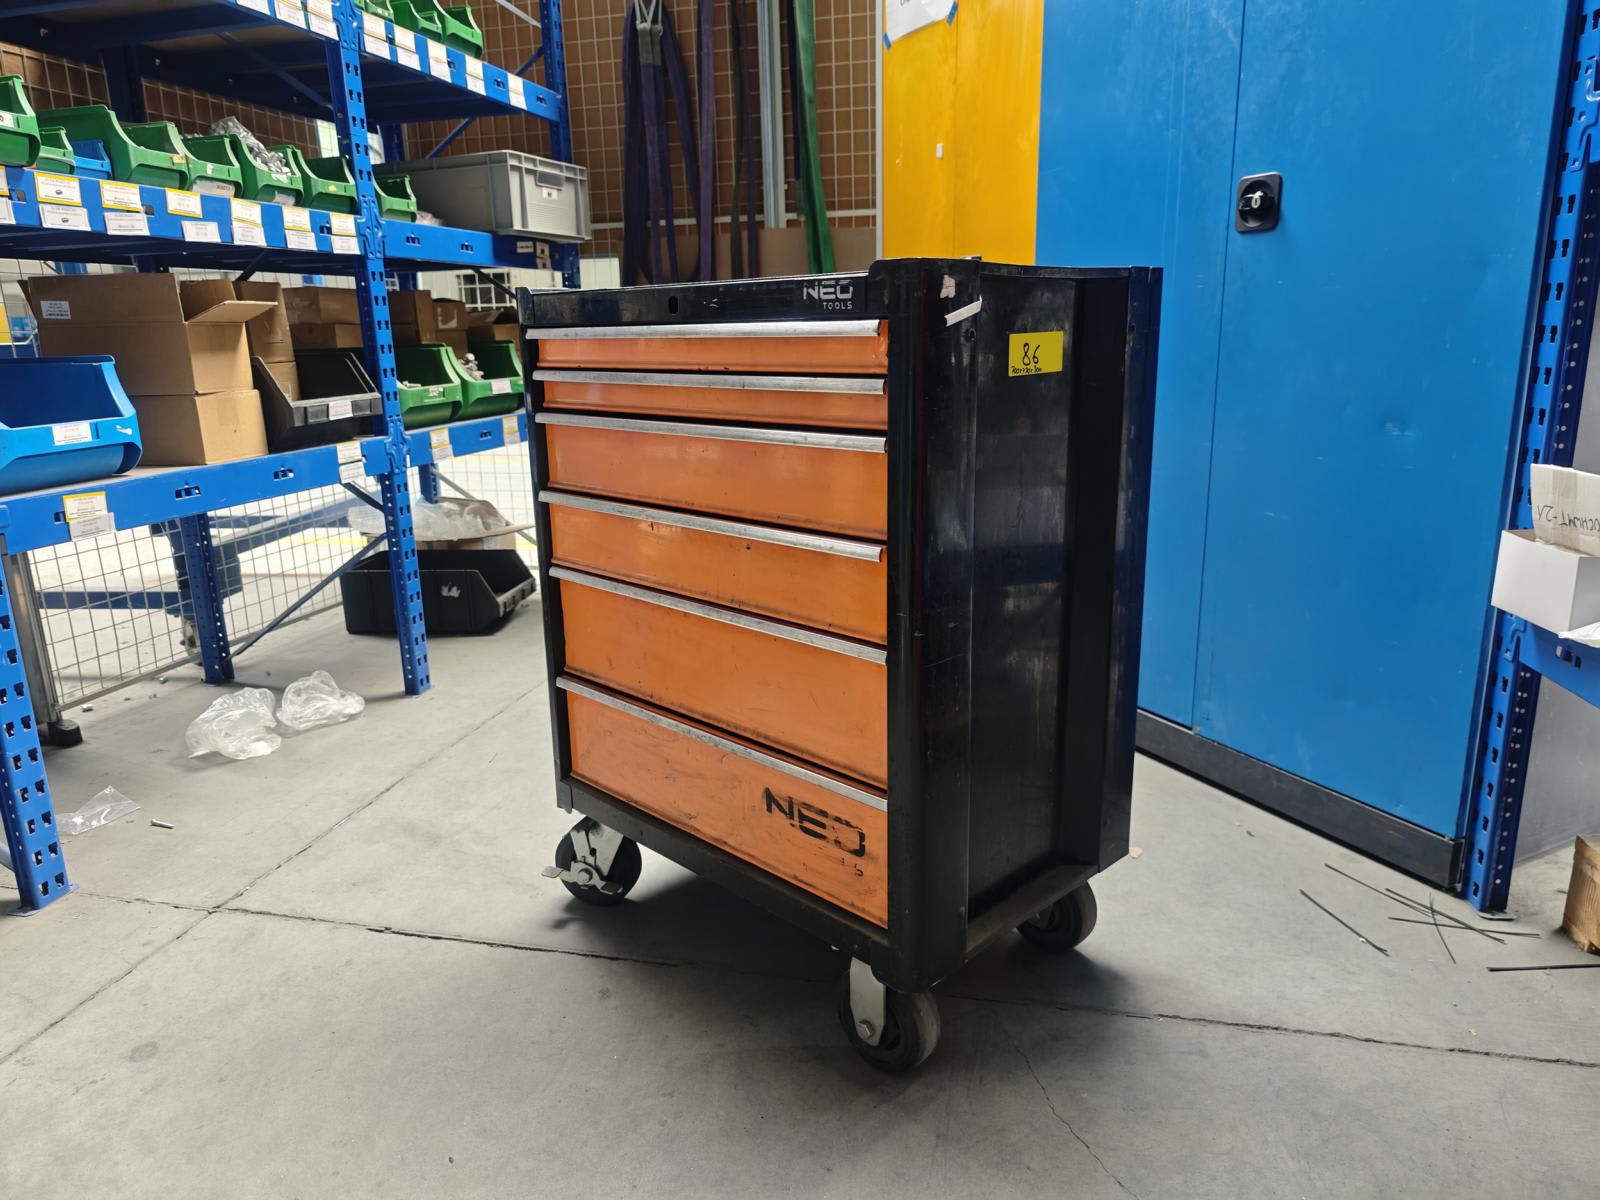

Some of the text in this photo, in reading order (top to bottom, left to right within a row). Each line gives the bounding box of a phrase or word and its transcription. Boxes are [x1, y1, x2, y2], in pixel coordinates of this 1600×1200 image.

[803, 280, 853, 300] NEO
[823, 301, 853, 310] TOOLS
[1022, 342, 1041, 366] 86
